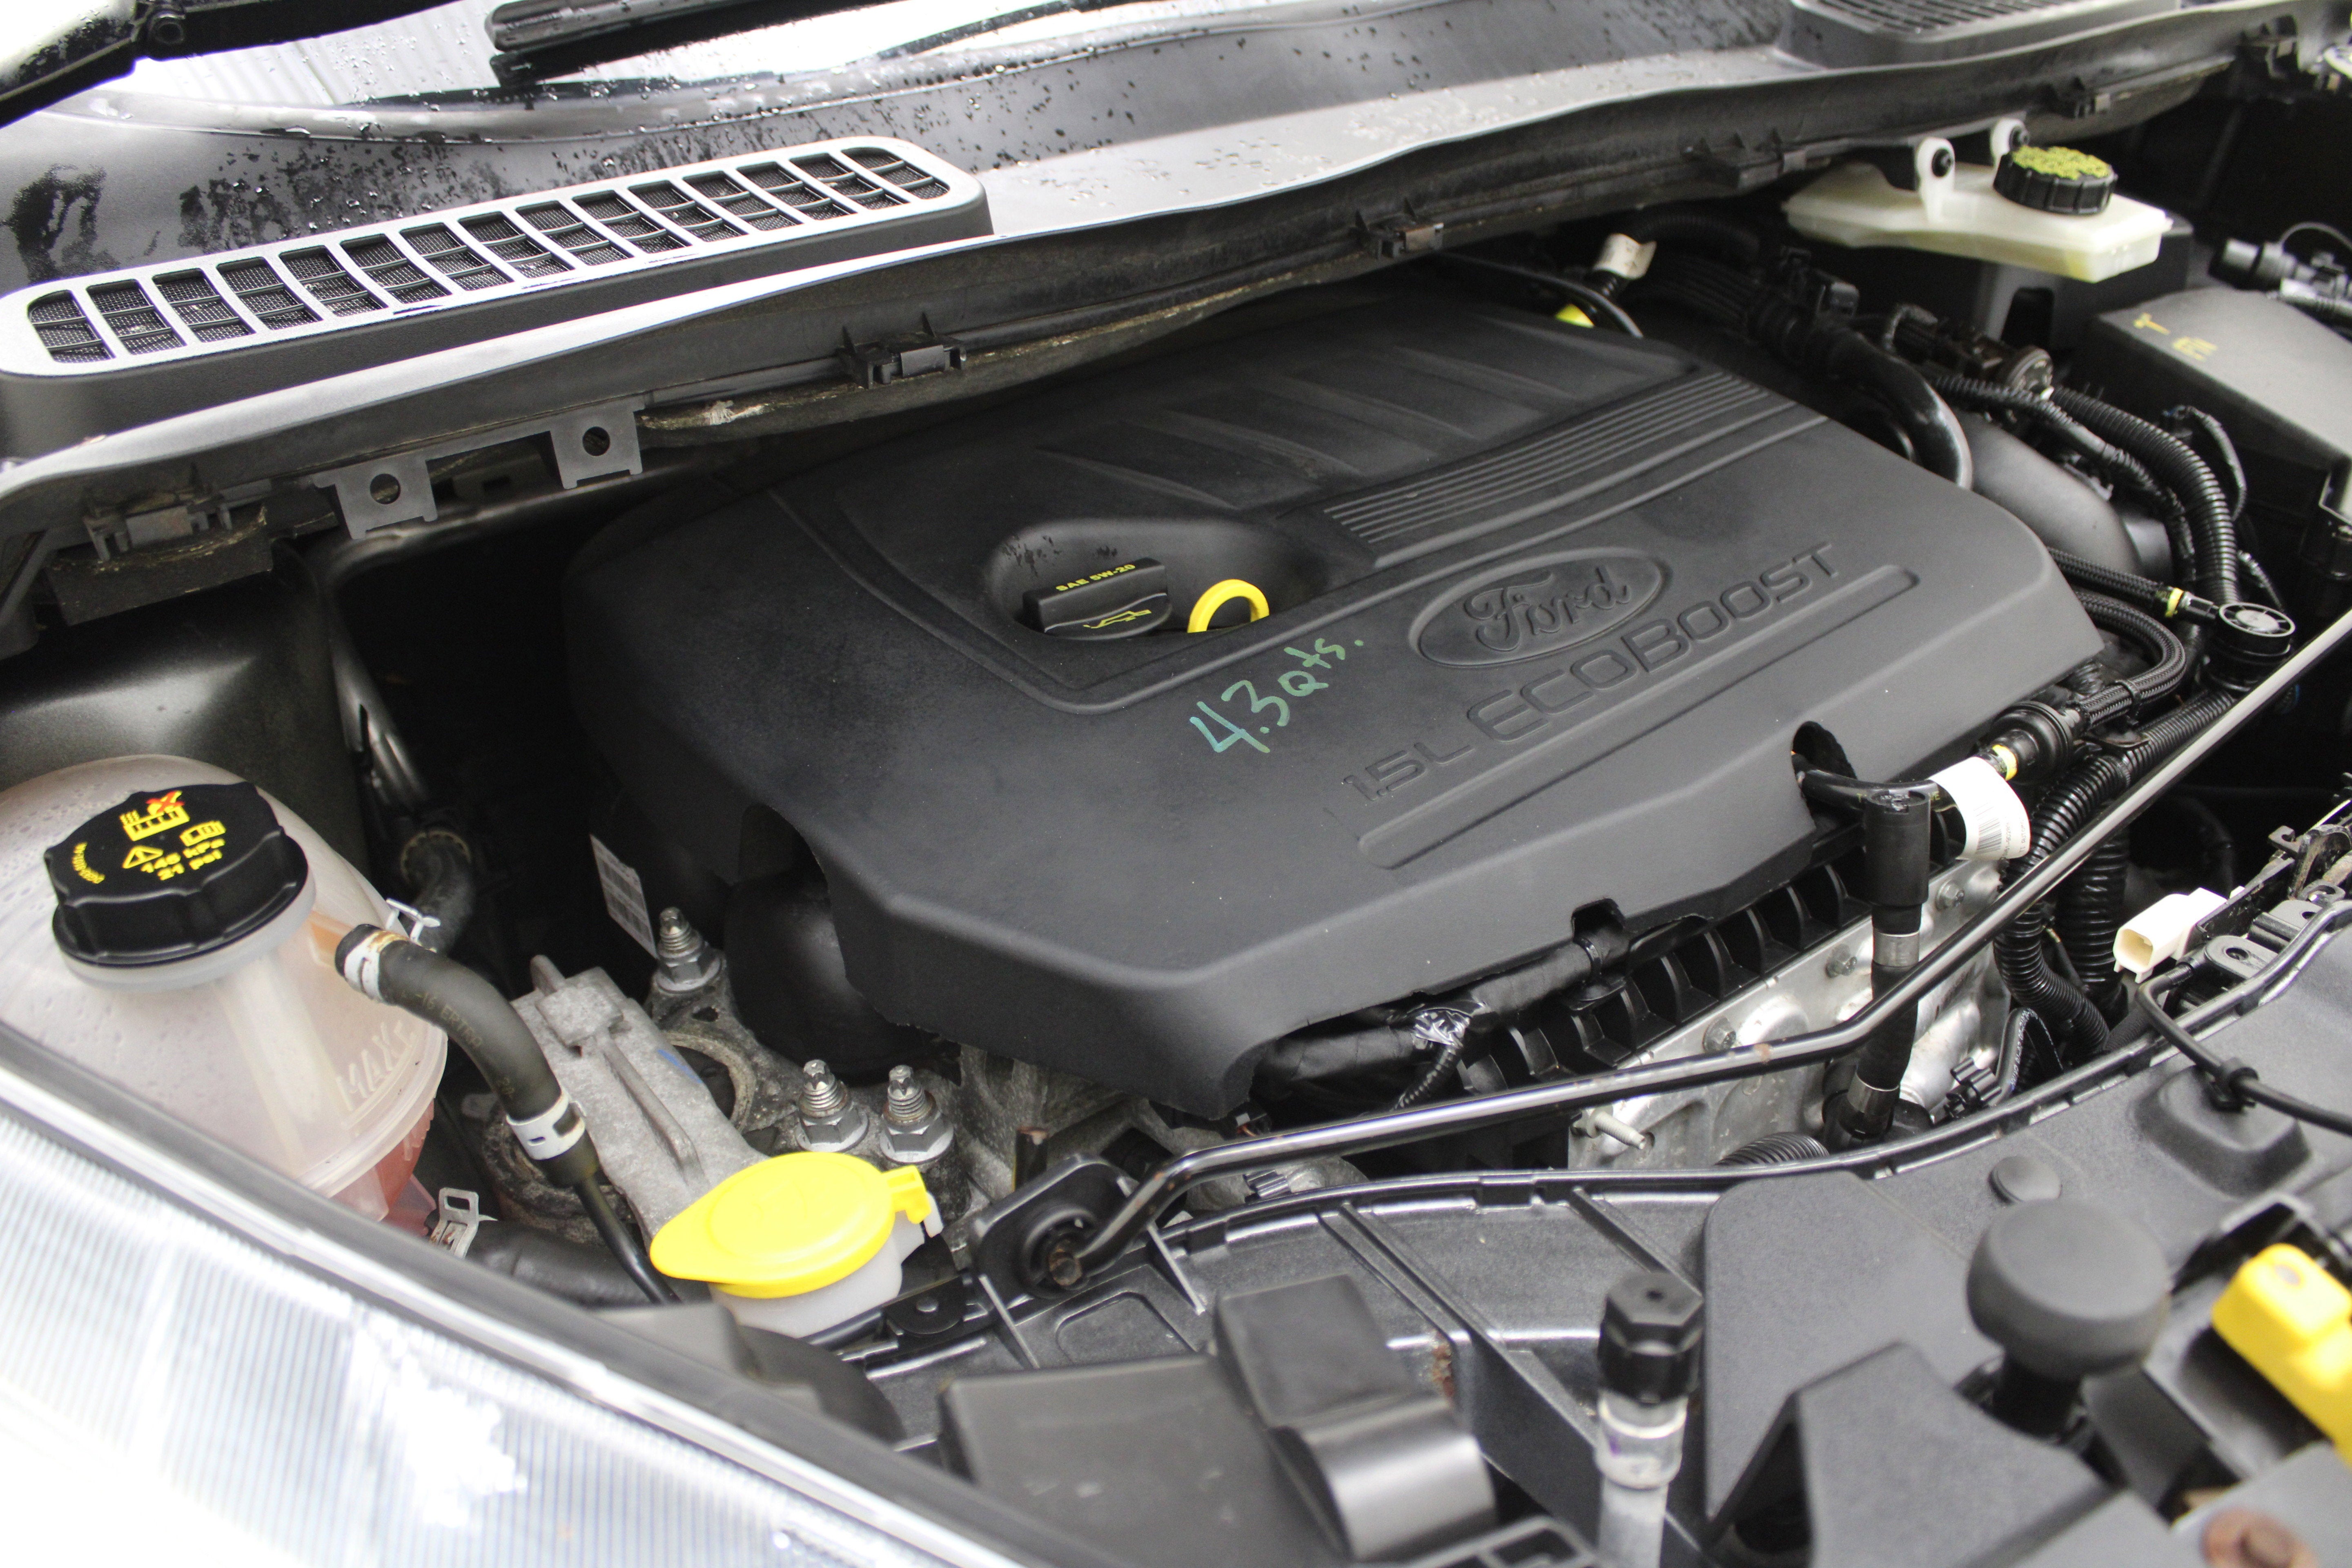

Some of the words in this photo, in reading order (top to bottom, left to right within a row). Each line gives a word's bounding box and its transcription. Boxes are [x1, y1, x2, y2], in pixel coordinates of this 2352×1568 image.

[1055, 578, 1090, 591] SAE
[1089, 564, 1136, 581] 5W-20
[1464, 566, 1632, 652] Ford
[1343, 742, 1477, 804] 1.5L
